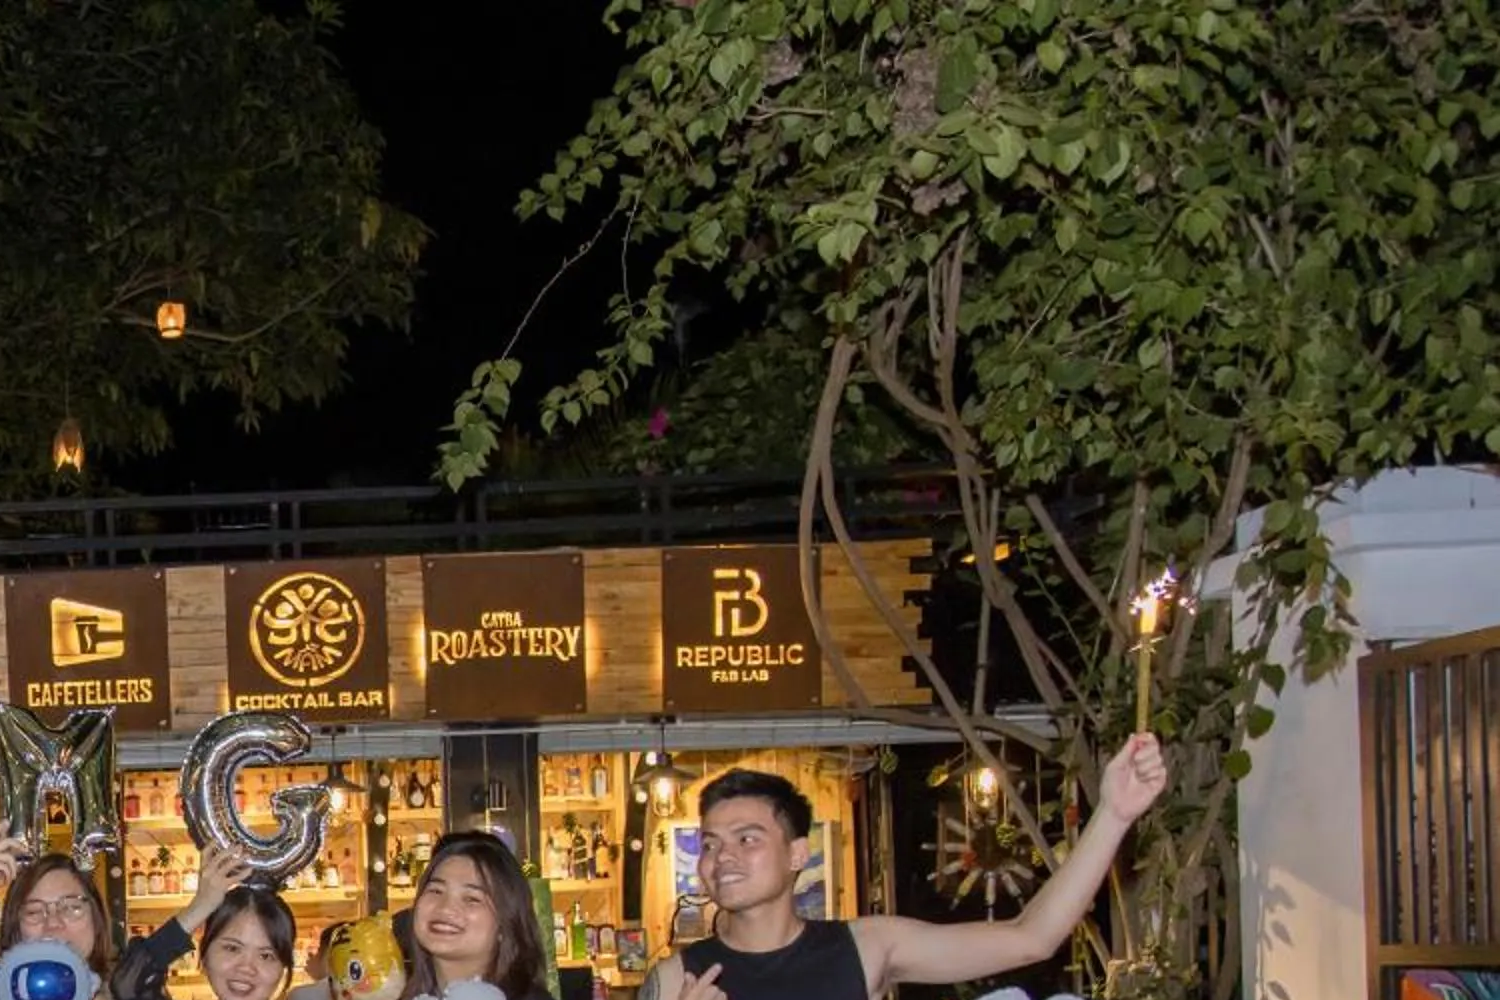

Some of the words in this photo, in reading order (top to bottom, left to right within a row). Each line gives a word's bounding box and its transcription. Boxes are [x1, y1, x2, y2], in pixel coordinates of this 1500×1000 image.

[430, 626, 581, 665] ROASTERY
[677, 643, 804, 667] REPUBLIC
[712, 669, 739, 682] F&B
[741, 669, 769, 682] LAB
[27, 678, 153, 707] CAFETELLERS
[236, 691, 335, 710] COCKTAIL
[339, 690, 384, 707] BAR
